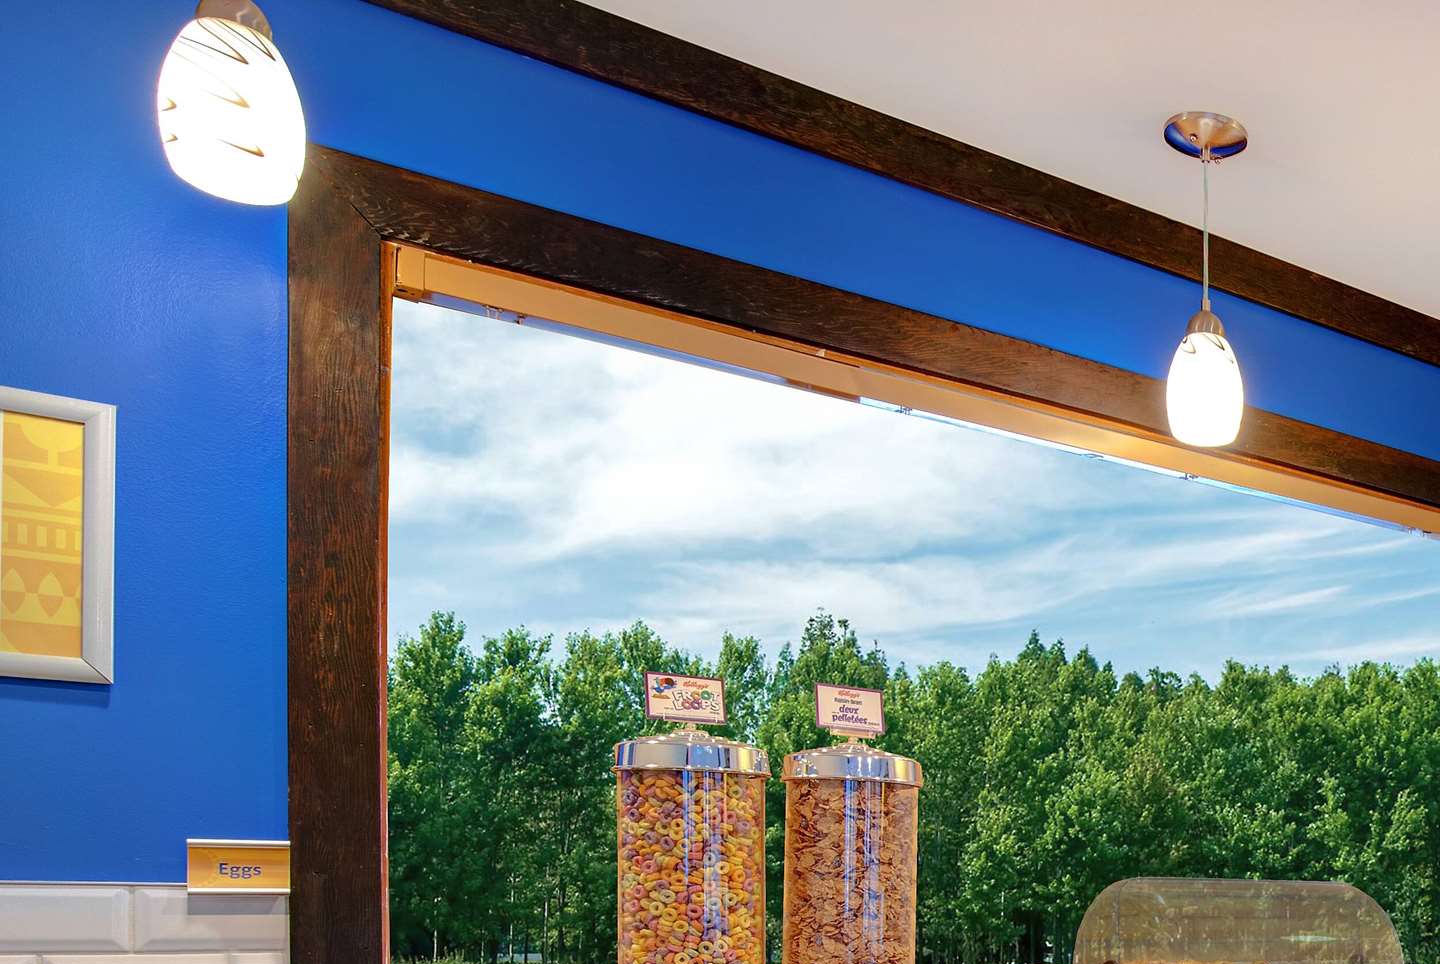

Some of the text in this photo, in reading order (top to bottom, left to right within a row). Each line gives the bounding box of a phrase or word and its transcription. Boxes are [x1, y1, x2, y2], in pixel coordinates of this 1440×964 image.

[672, 690, 720, 701] FROOT
[672, 699, 720, 711] LOOPS
[219, 862, 262, 879] Eggs
